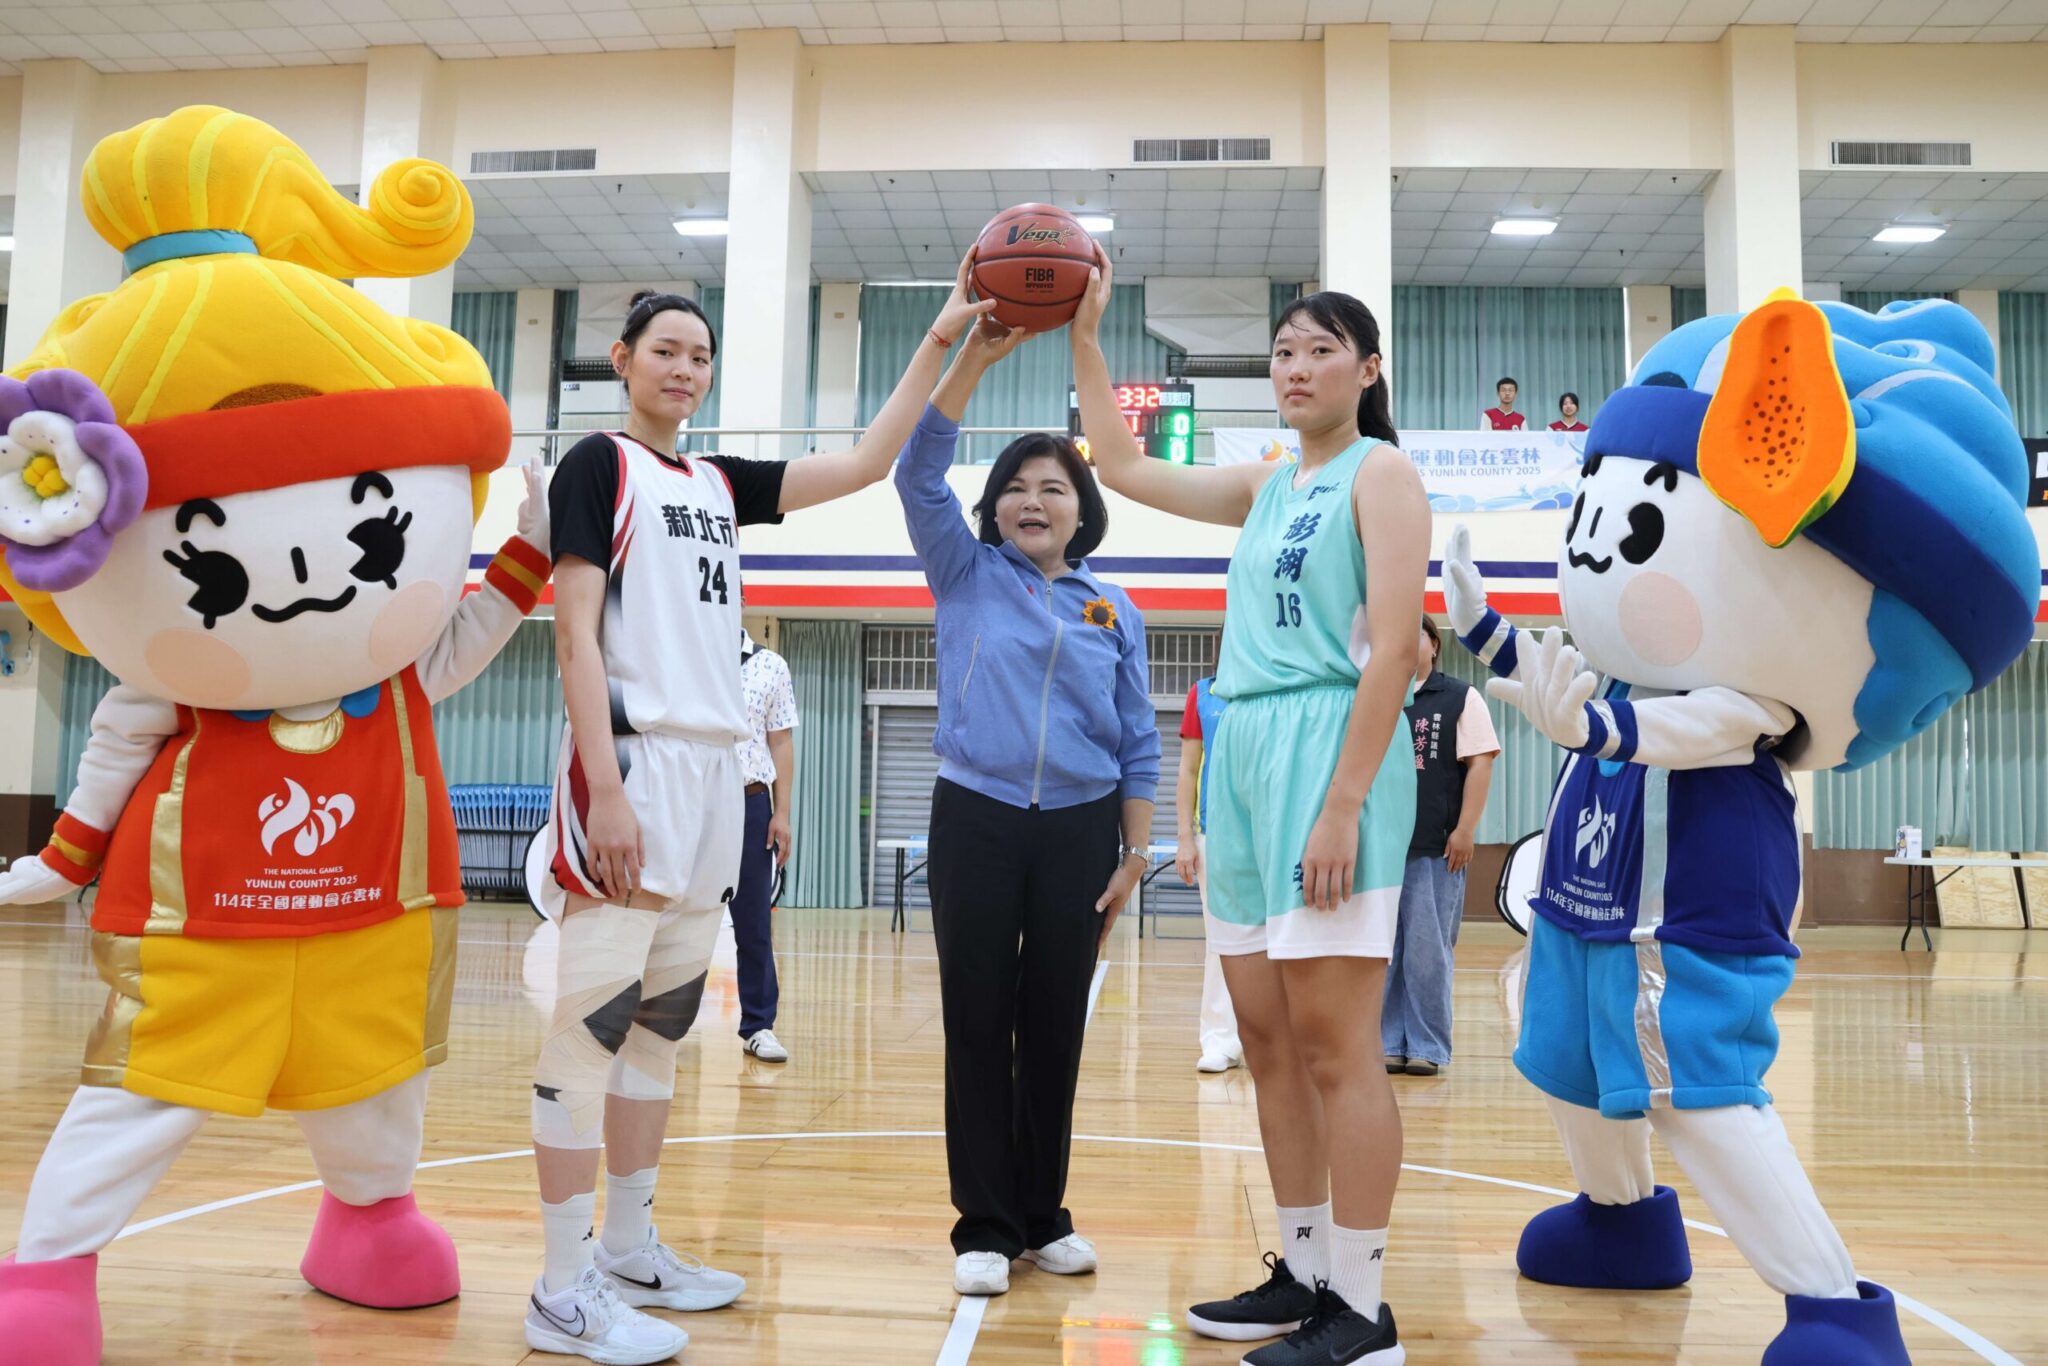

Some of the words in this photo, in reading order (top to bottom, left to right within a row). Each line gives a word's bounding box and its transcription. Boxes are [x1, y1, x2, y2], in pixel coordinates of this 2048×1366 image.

[1006, 222, 1061, 246] Vega
[1025, 267, 1055, 281] FIBA
[1173, 413, 1190, 436] 0
[1402, 447, 1541, 467] 運動會在雲林
[1429, 467, 1467, 477] YUNLIN
[1470, 467, 1512, 476] COUNTY
[1516, 466, 1541, 475] 2025
[661, 504, 734, 548] 新北市
[1274, 513, 1322, 583] 澎湖
[698, 556, 728, 605] 24
[1276, 592, 1302, 628] 16
[245, 879, 286, 889] YUNLIN
[288, 878, 331, 889] COUNTY
[333, 874, 358, 886] 2025
[264, 867, 279, 875] THE
[280, 867, 317, 875] NATIONAL
[319, 866, 343, 874] GAMES
[214, 886, 381, 910] 114年全國運動會在雲林
[1562, 881, 1583, 897] YUNLIN
